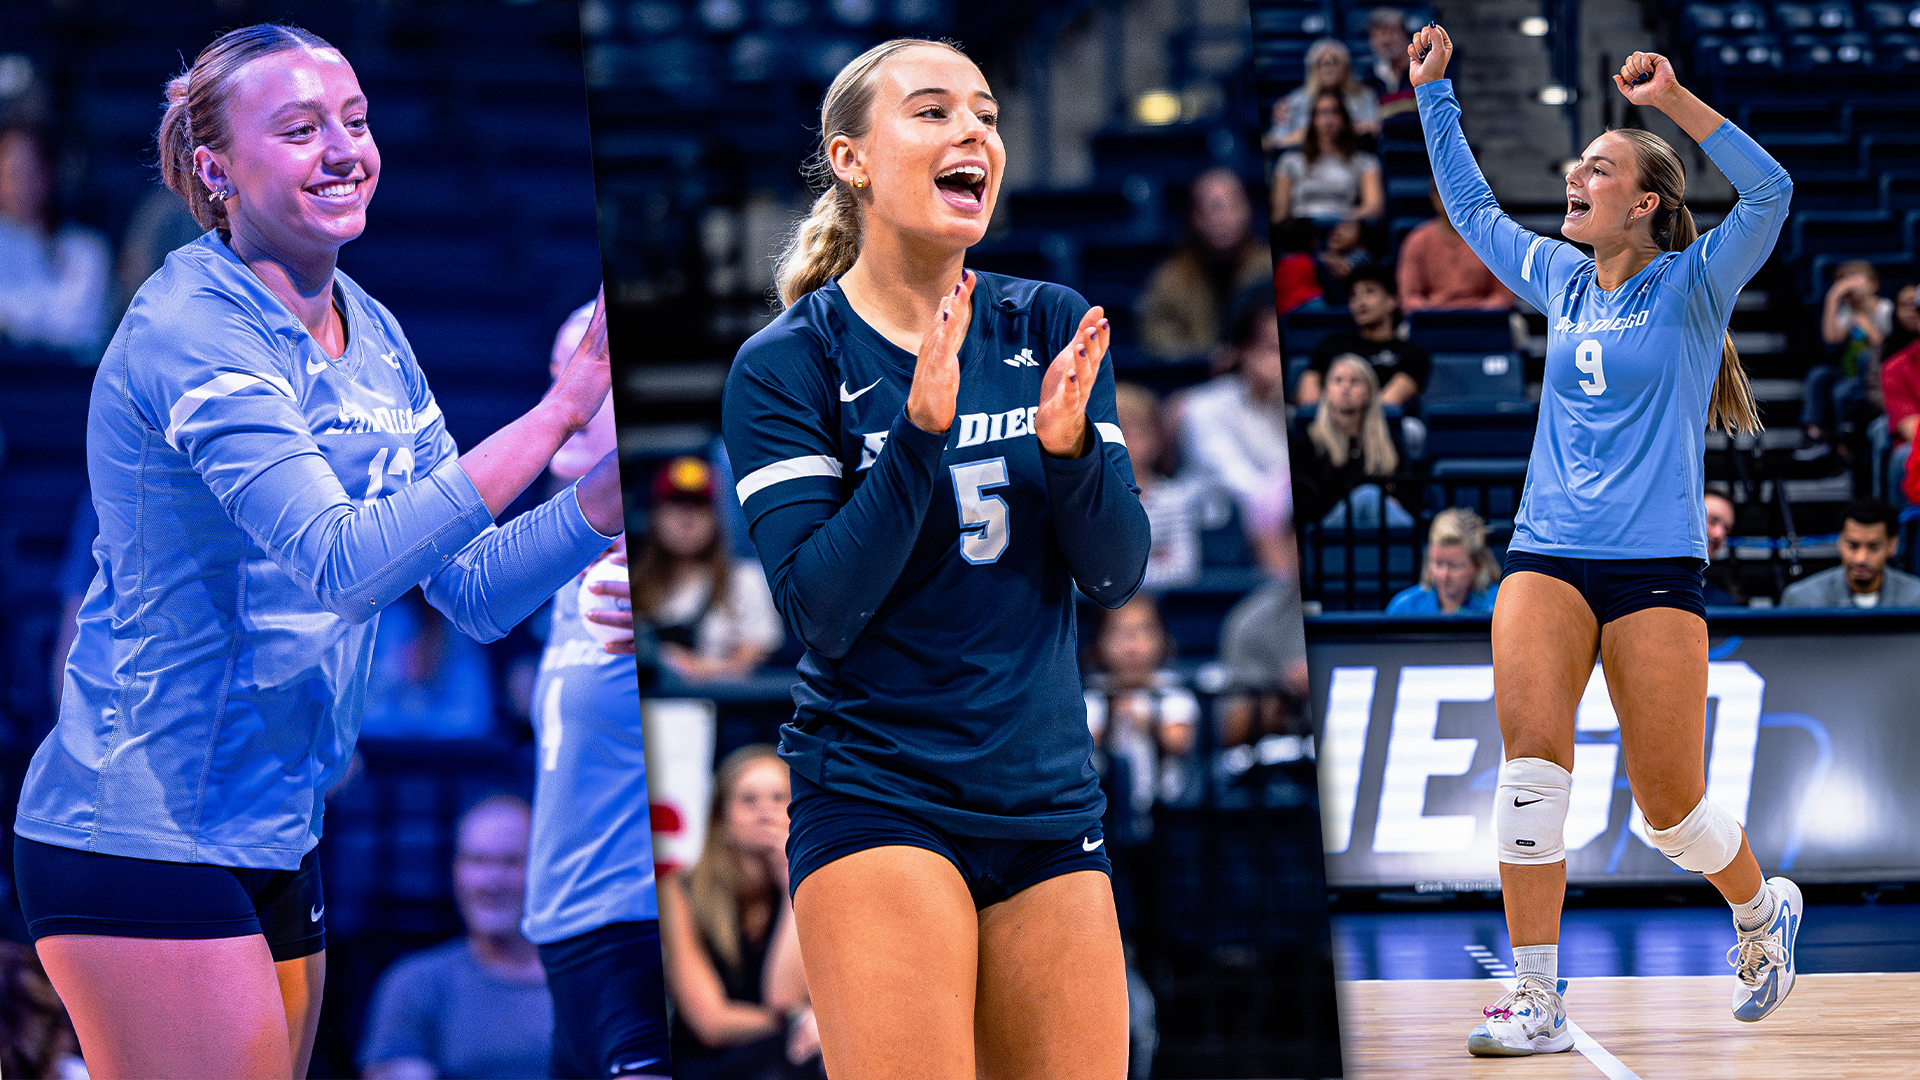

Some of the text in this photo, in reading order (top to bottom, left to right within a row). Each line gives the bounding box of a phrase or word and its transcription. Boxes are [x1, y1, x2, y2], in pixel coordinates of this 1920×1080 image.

[1554, 310, 1650, 334] SAN DIEGO
[1575, 339, 1607, 396] 9
[949, 456, 1010, 566] 5
